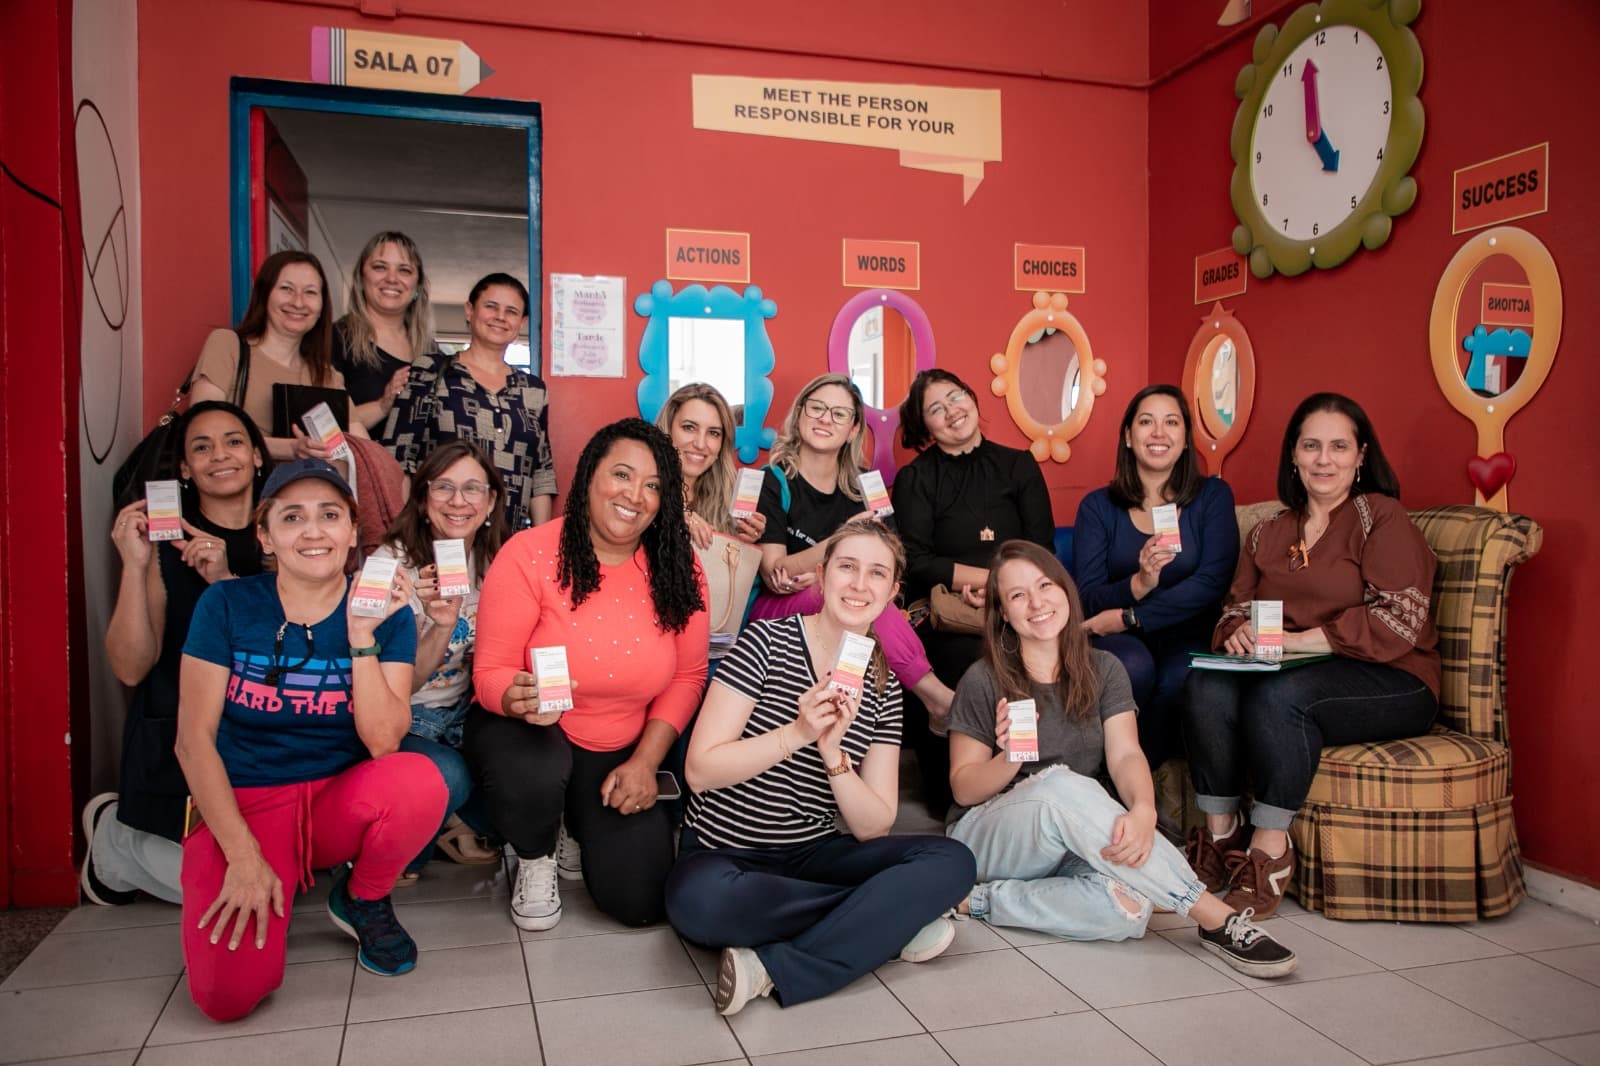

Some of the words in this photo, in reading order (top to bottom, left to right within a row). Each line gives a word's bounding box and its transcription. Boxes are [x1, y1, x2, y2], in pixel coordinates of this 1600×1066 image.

[1314, 31, 1326, 47] 12
[1353, 31, 1359, 44] 1
[353, 49, 419, 75] SALA
[426, 56, 454, 77] 07
[1283, 63, 1293, 78] 11
[1376, 56, 1383, 71] 2
[763, 87, 812, 104] MEET
[817, 92, 852, 107] THE
[858, 95, 929, 114] PERSON
[1383, 100, 1390, 115] 3
[1263, 104, 1273, 119] 10
[734, 104, 861, 127] RESPONSIBLE
[867, 115, 902, 130] FOR
[908, 119, 955, 135] YOUR
[1256, 151, 1262, 164] 9
[1376, 147, 1383, 161] 4
[1461, 169, 1539, 211] SUCCESS
[1262, 193, 1269, 207] 8
[1351, 195, 1357, 209] 5
[1283, 218, 1289, 232] 7
[1312, 223, 1319, 236] 6
[676, 246, 741, 266] ACTIONS
[857, 254, 906, 273] WORDS
[1022, 259, 1078, 278] CHOICES
[1202, 261, 1240, 286] GRADES
[226, 686, 284, 713] HARD
[290, 698, 338, 715] THE
